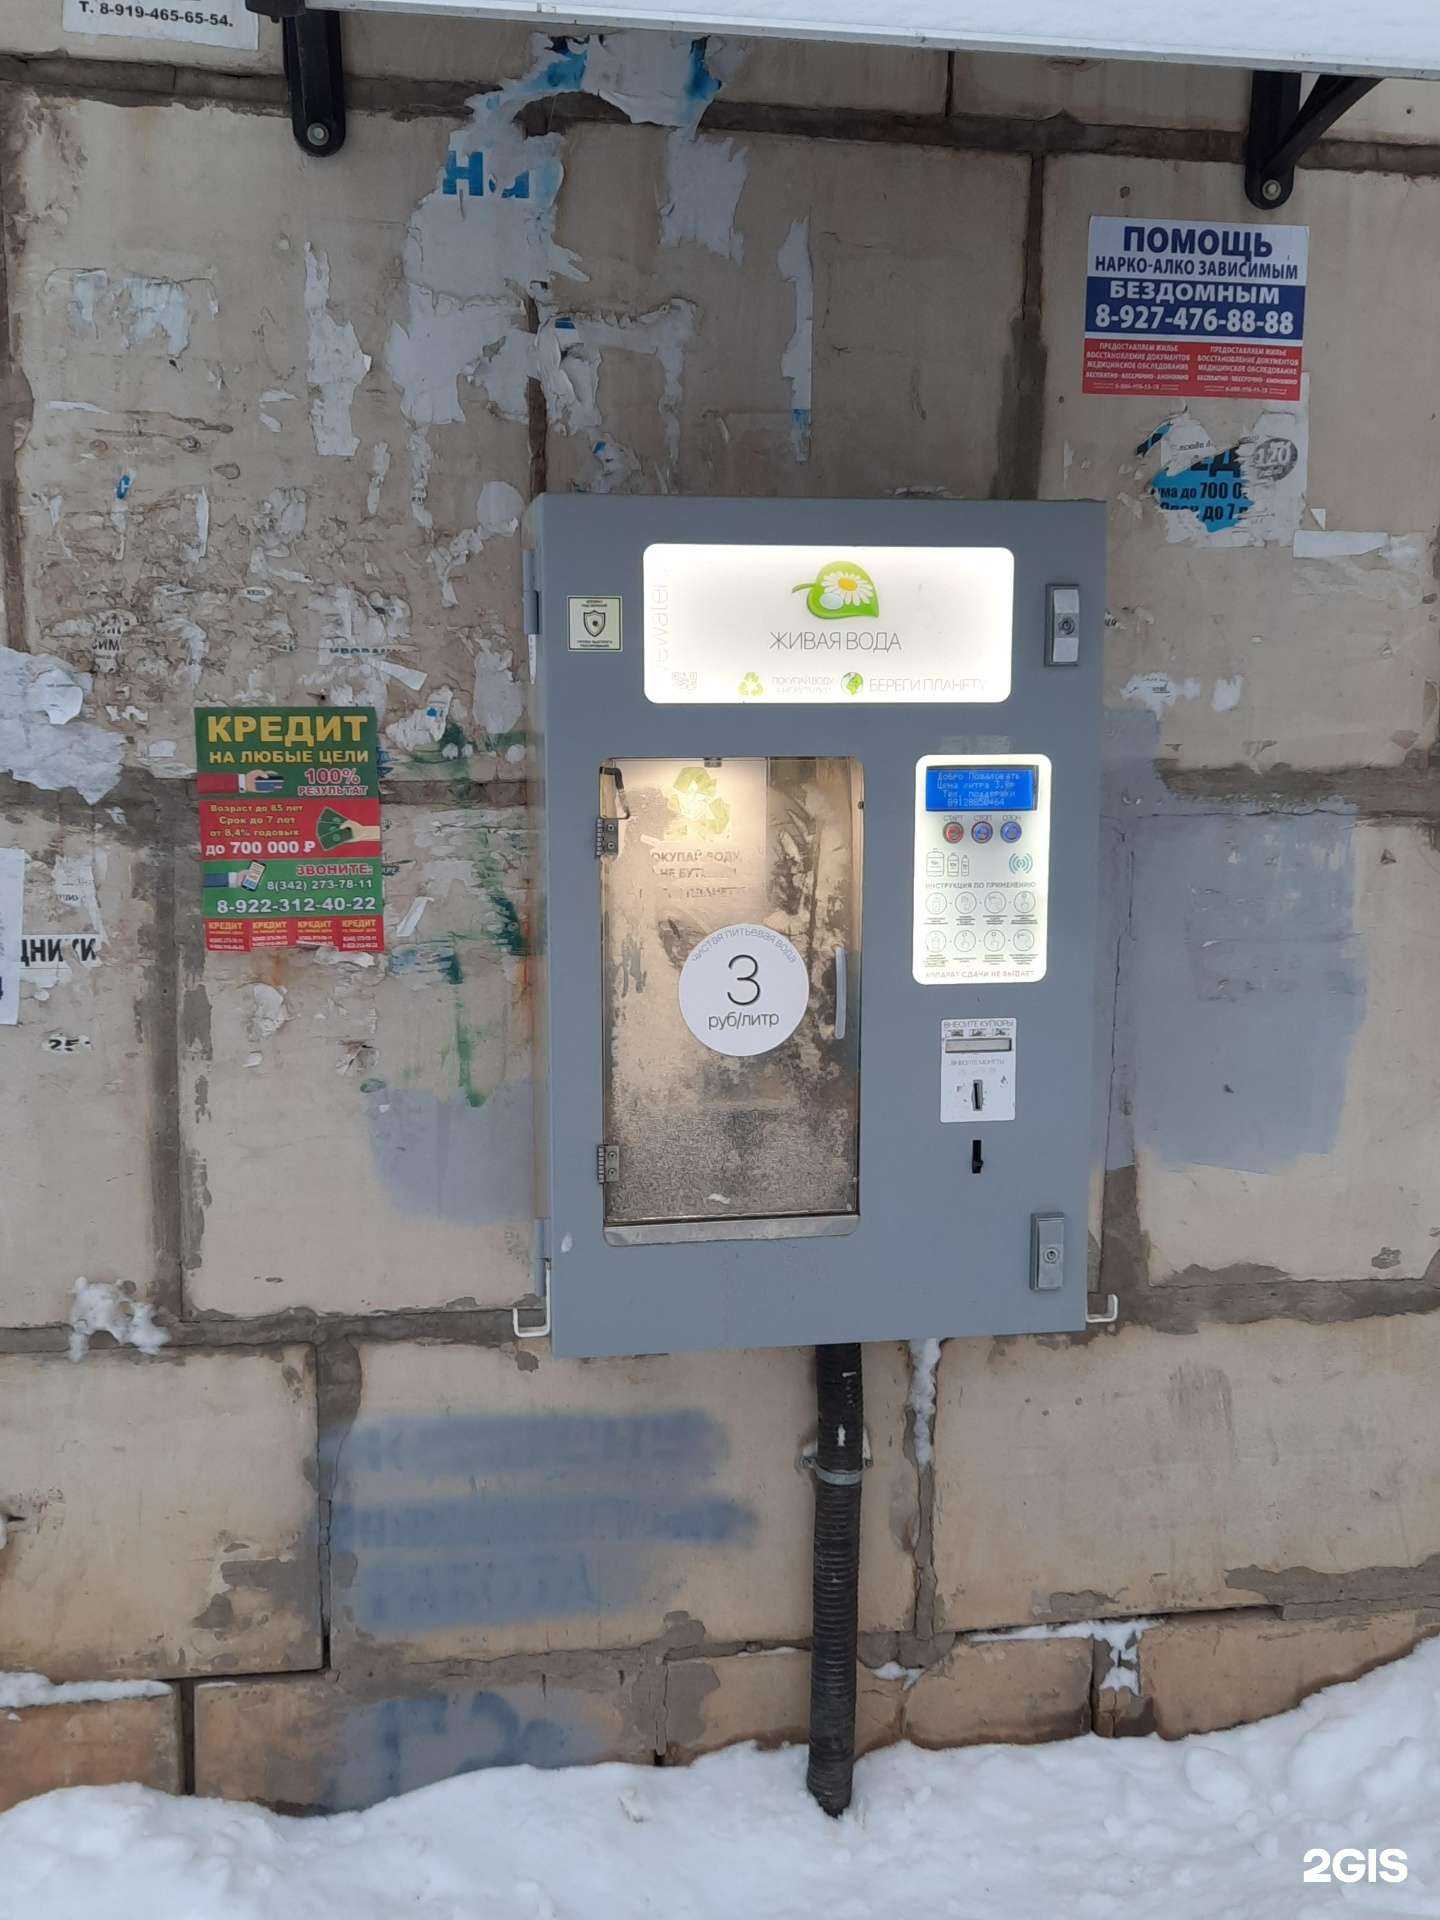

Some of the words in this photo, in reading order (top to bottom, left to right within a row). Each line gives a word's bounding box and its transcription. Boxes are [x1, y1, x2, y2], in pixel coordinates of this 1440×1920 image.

[99, 3, 234, 27] 8-919-465-65-54.
[1123, 226, 1273, 262] ПОМОЩЬ
[1095, 256, 1195, 275] НАРКО-АЛКО
[1199, 260, 1298, 280] ЗАВИСИМЫМ
[1109, 280, 1280, 305] БЕЗДОМНЫМ
[1095, 304, 1294, 335] 8-927-476-88-88
[1200, 482, 1229, 499] 700
[768, 631, 841, 651] ЖИВАЯ
[845, 631, 902, 654] ВОДА
[868, 678, 921, 693] БЕРЕГИ
[207, 715, 368, 747] КРЕДИТ
[209, 751, 236, 764] НА
[240, 750, 313, 764] ЛЮБЫЕ
[319, 750, 369, 765] ЦЕЛИ
[304, 768, 361, 785] 100%
[297, 785, 369, 796] РЕЗУЛЬТАТ
[210, 804, 252, 813] Возраст
[255, 805, 267, 813] до
[285, 804, 304, 812] лет
[219, 816, 246, 826] Срок
[250, 817, 264, 825] до
[267, 816, 273, 824] 7
[210, 830, 221, 838] от
[254, 829, 299, 838] годовых
[205, 844, 226, 856] до
[230, 841, 262, 855] 700
[267, 840, 299, 854] 000
[296, 863, 374, 876] ЗВОНИТЕ:
[267, 880, 308, 891] 8(342)
[311, 879, 373, 890] 273-78-11
[216, 897, 376, 914] 8-922-312-40-22
[208, 921, 242, 930] КРЕДИТ
[252, 920, 287, 930] КРЕДИТ
[297, 920, 332, 929] КРЕДИТ
[342, 919, 376, 928] КРЕДИТ
[727, 954, 760, 1006] 3
[708, 1011, 779, 1031] руб/литр
